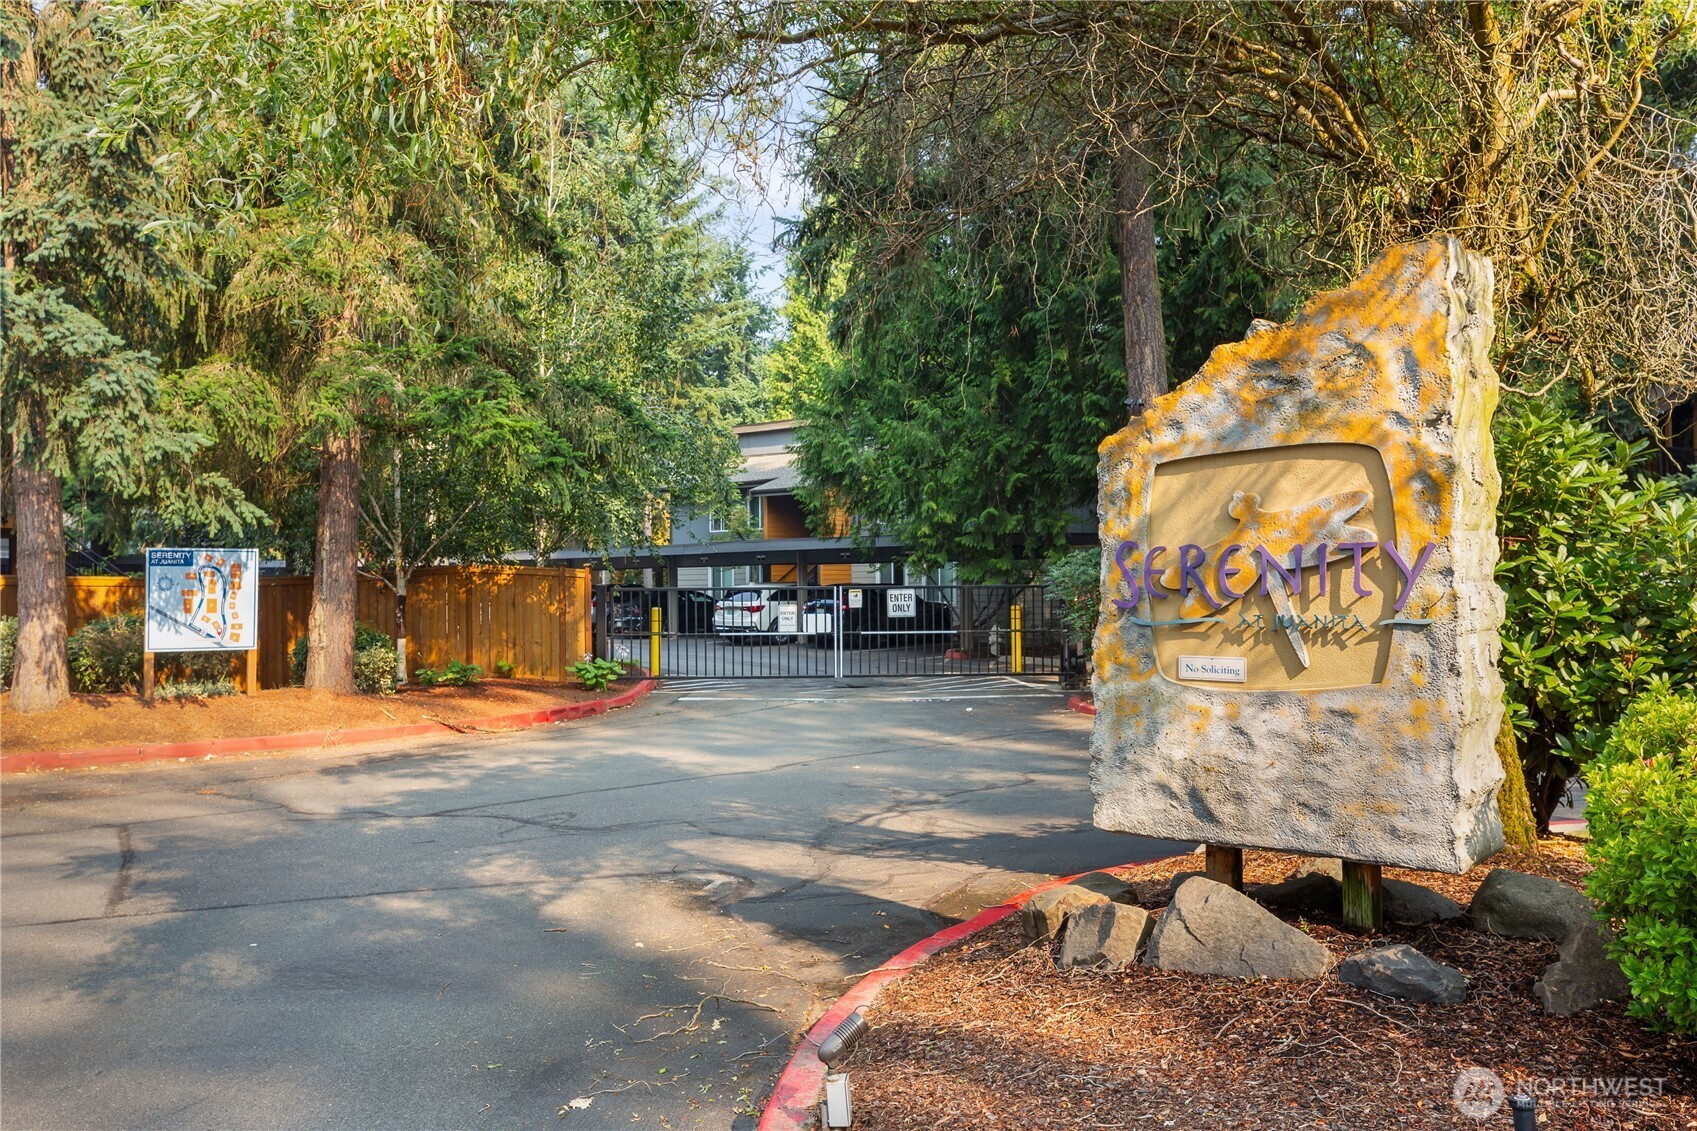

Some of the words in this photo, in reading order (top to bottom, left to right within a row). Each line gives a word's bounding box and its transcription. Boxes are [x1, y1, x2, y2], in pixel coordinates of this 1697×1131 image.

[151, 551, 191, 559] SERENITY
[1113, 540, 1437, 612] SERENITY
[889, 593, 913, 602] ENTER
[892, 603, 911, 613] ONLY
[1238, 612, 1265, 631] AT
[1271, 612, 1368, 635] JUANITA
[1185, 663, 1199, 673] No
[1201, 664, 1240, 677] Soliciting
